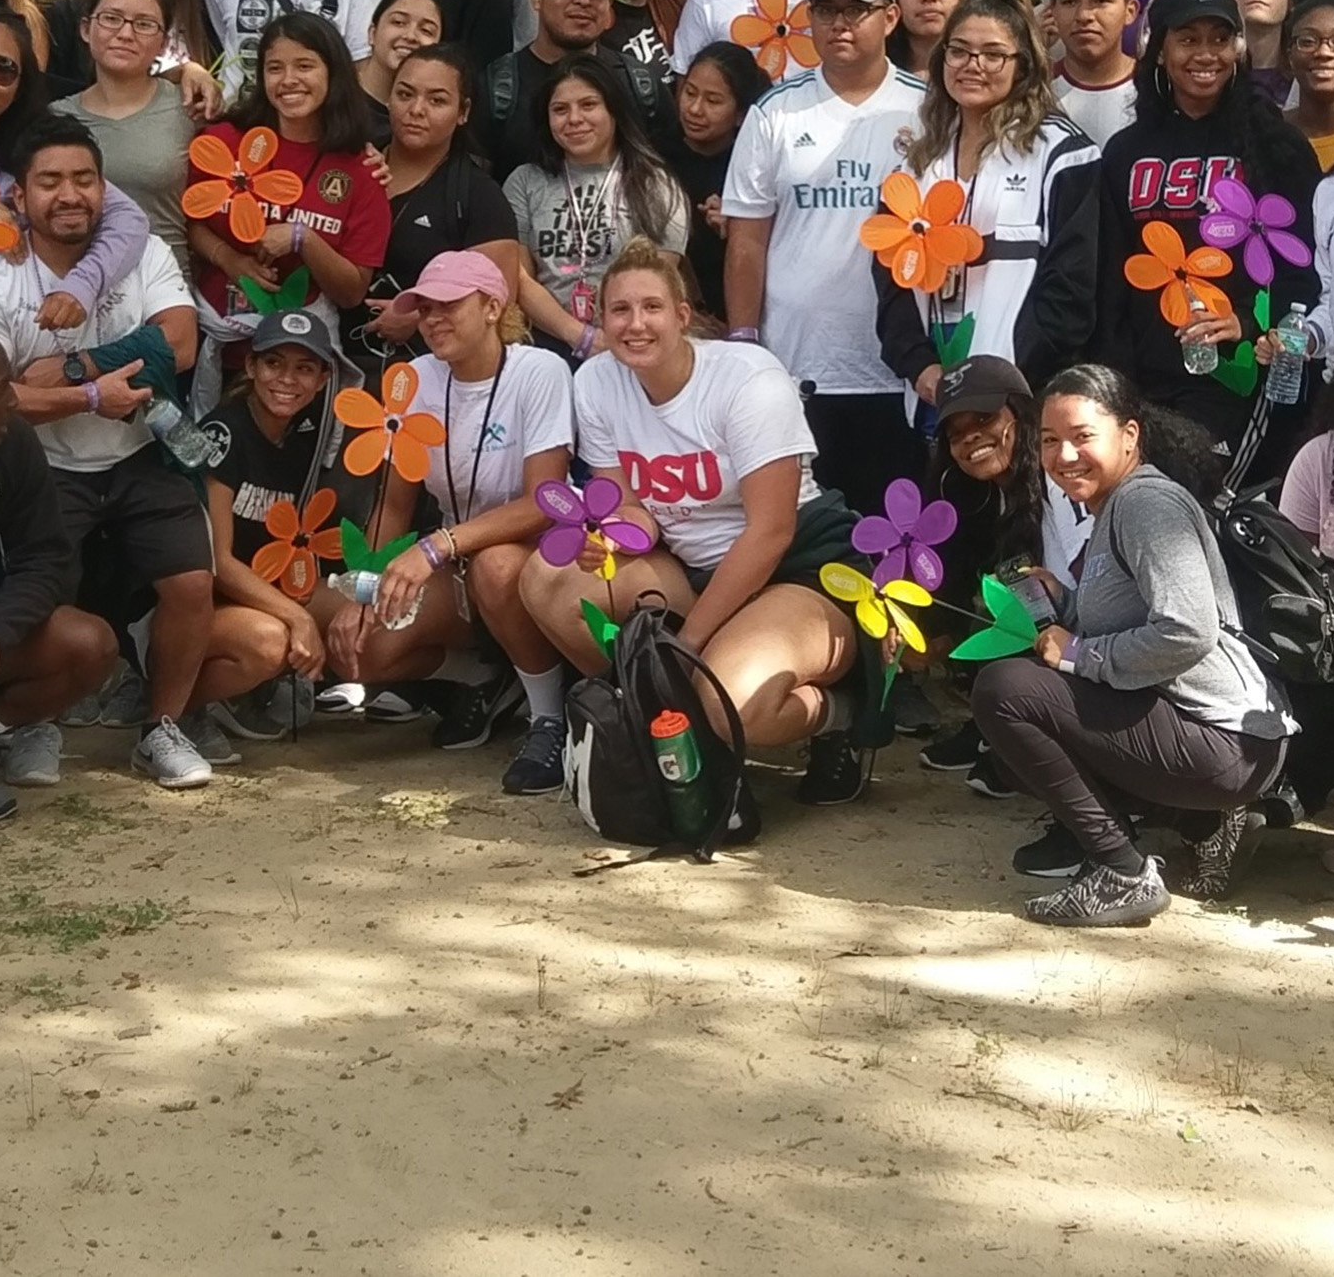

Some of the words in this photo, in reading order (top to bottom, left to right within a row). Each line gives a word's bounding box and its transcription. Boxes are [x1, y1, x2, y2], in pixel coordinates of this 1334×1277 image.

[836, 159, 871, 181] Fly
[792, 181, 876, 210] Emira
[286, 207, 342, 235] UNITED
[538, 228, 616, 258] BEAST
[617, 450, 723, 504] DSU
